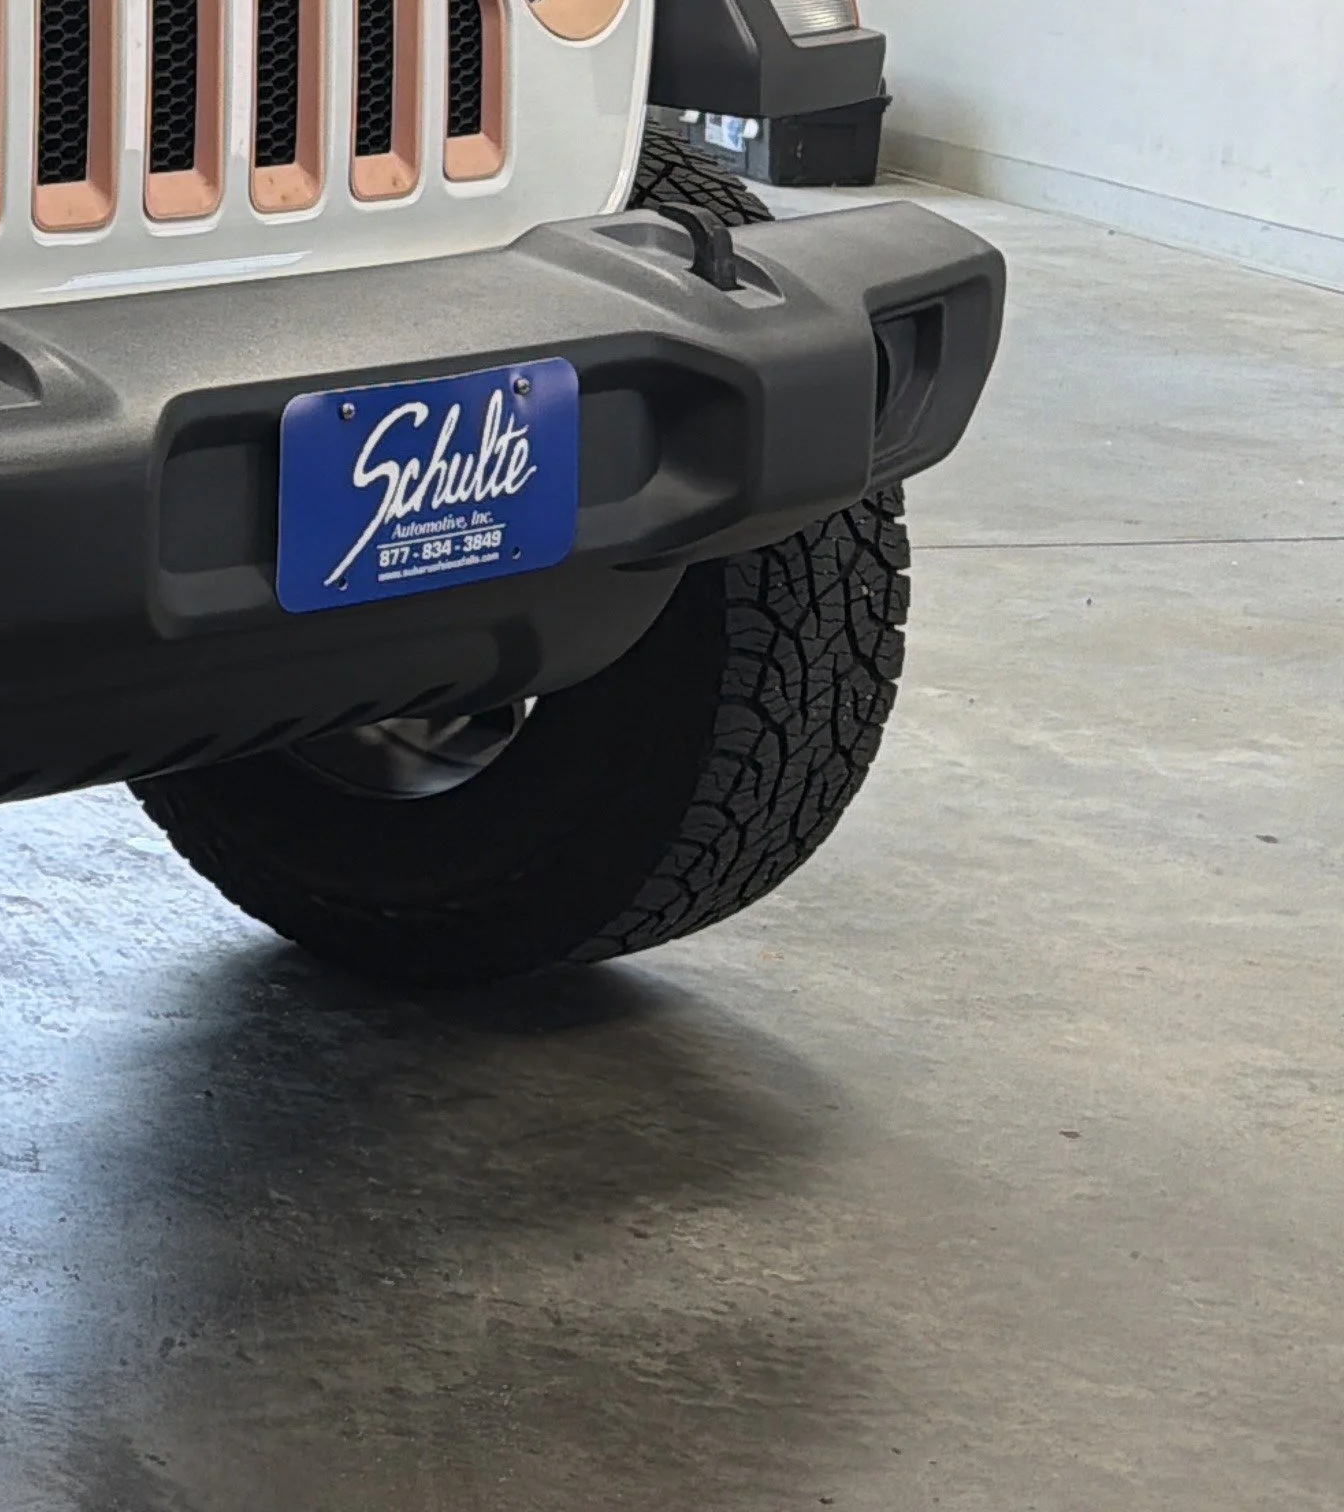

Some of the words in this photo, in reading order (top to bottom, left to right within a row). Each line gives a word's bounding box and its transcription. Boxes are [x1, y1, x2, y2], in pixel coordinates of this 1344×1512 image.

[323, 389, 537, 587] Schulte
[471, 509, 494, 526] Inc.
[379, 547, 410, 567] 877
[421, 540, 452, 560] 834
[462, 530, 502, 552] 3849
